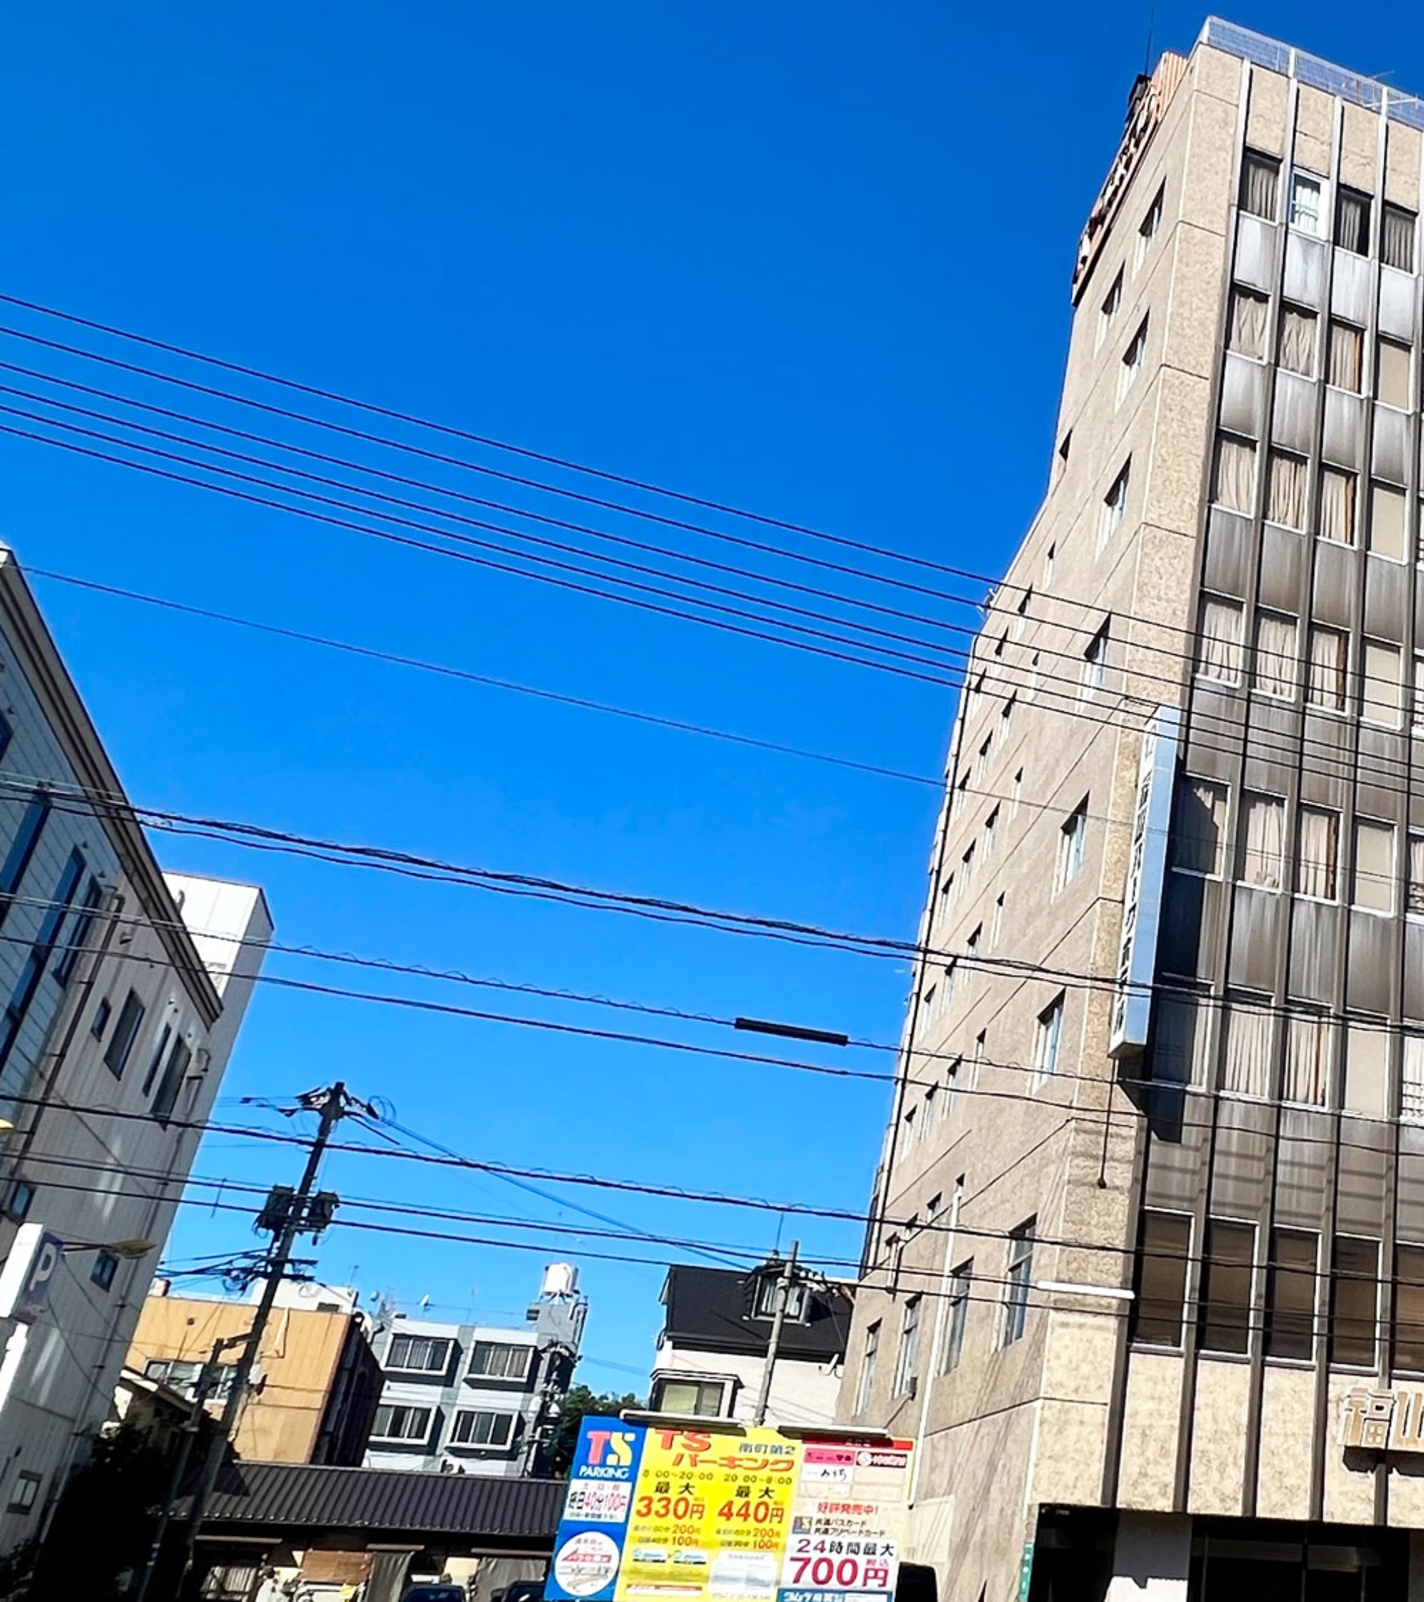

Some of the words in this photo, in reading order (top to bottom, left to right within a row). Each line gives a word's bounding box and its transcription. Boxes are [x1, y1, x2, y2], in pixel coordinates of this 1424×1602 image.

[29, 1242, 57, 1291] P
[587, 1431, 636, 1466] TS
[655, 1429, 711, 1452] TS
[579, 1465, 629, 1479] PARKING
[672, 1453, 795, 1472] パーキング
[636, 1495, 706, 1520] 330円
[717, 1500, 784, 1524] 440円
[796, 1538, 895, 1557] 24時間最大
[789, 1556, 890, 1588] 700円
